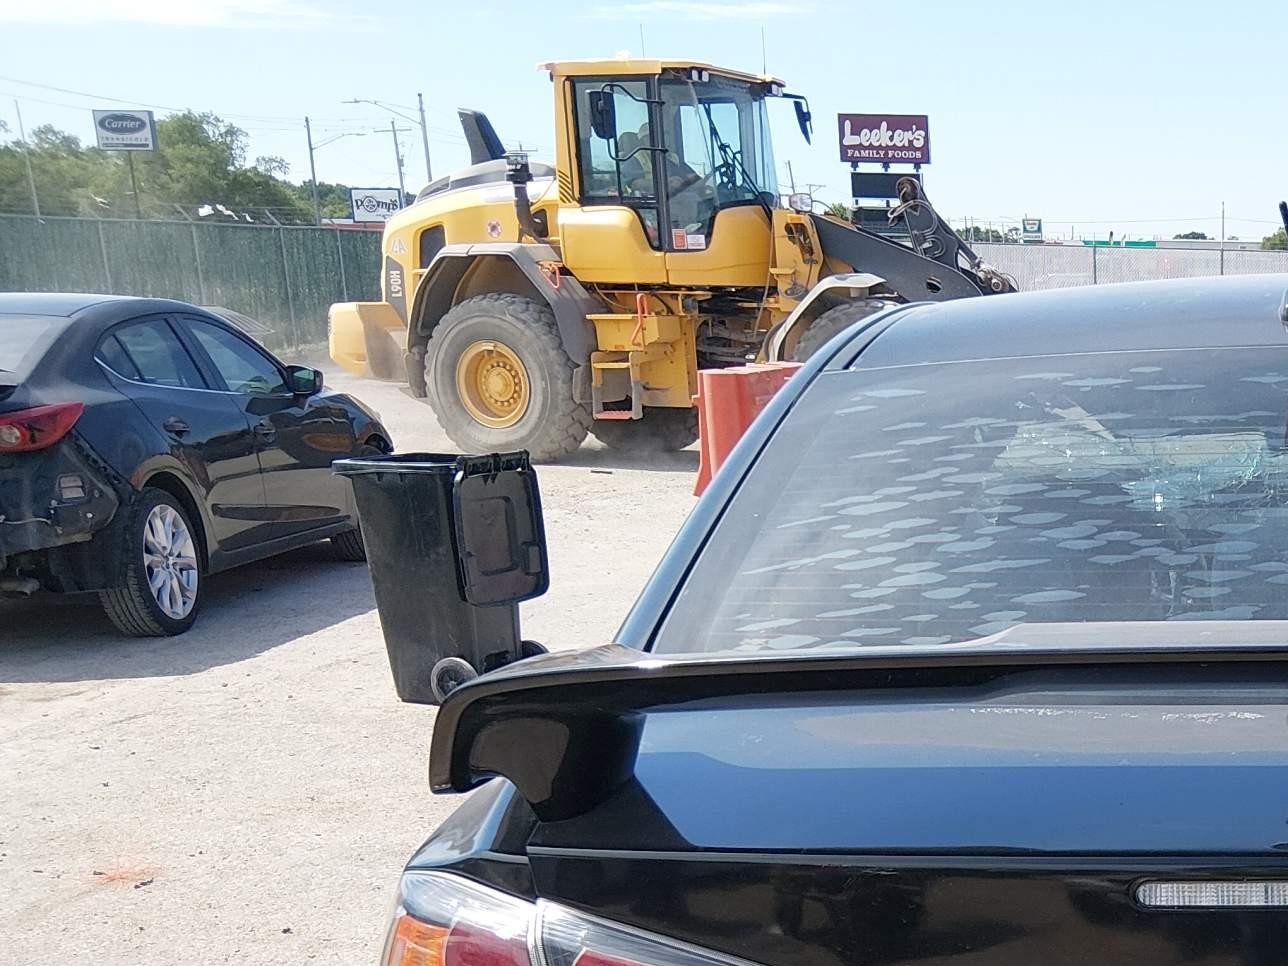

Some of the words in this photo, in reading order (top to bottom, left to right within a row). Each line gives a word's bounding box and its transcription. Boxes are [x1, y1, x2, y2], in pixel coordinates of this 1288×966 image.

[105, 118, 141, 129] Carrier
[842, 119, 926, 148] Leeker's
[847, 149, 886, 159] FAMILY
[887, 150, 923, 160] FOODS
[390, 270, 403, 298] L90H
